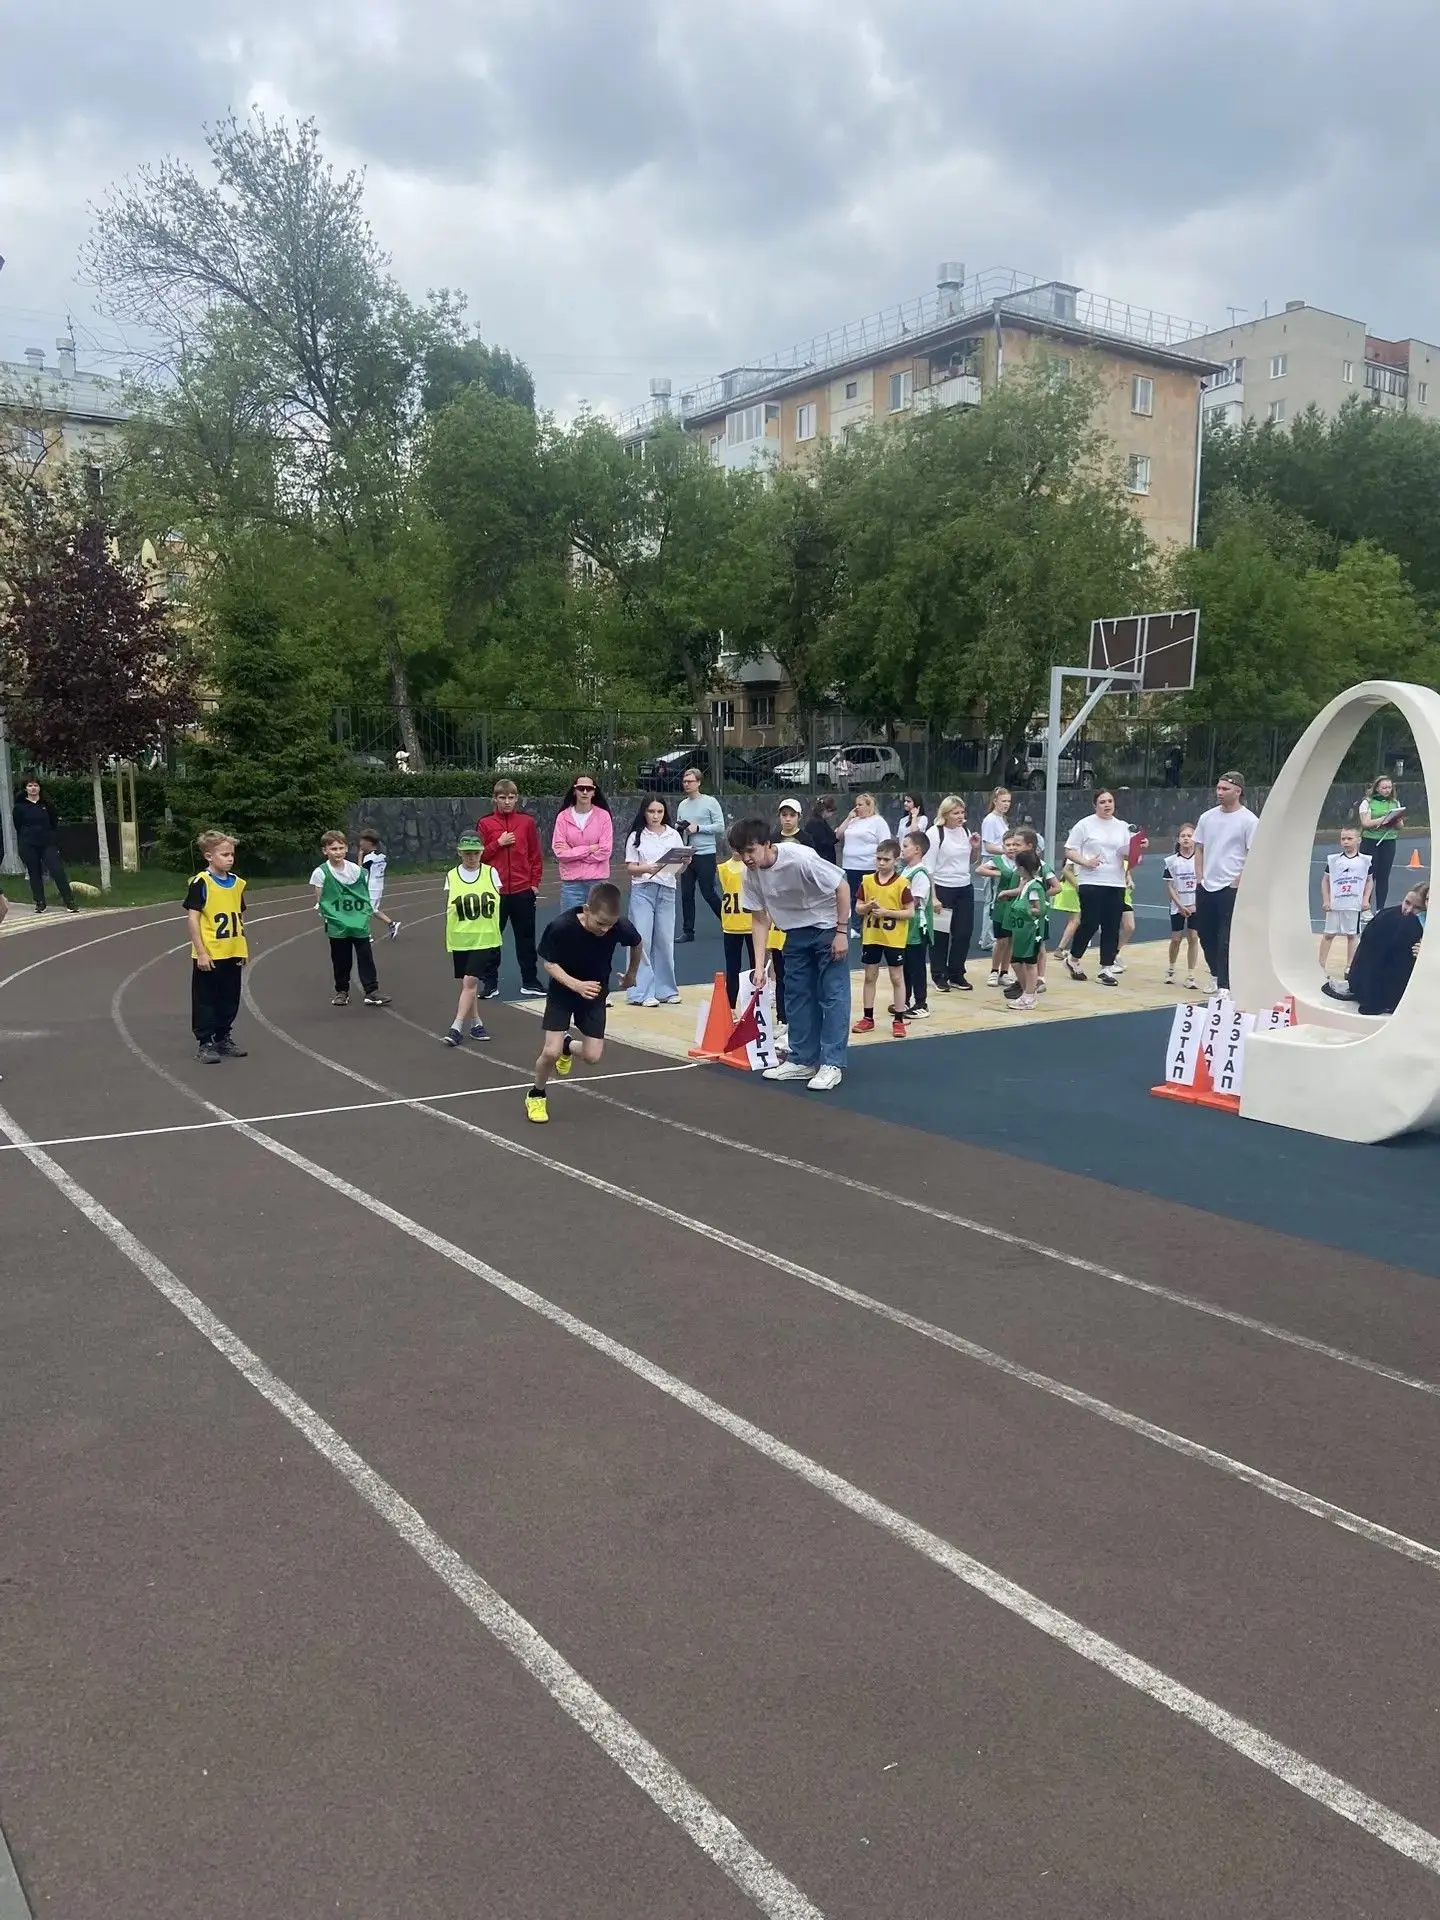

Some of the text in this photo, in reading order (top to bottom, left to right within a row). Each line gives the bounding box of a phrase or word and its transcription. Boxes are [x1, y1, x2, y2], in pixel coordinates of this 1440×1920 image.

[331, 899, 365, 912] 180
[451, 891, 496, 922] 106
[1215, 998, 1223, 1011] 1
[1270, 1011, 1280, 1024] 5
[1172, 1004, 1194, 1079] 3 ЭТАП
[1220, 1012, 1242, 1089] 2 ЭТАП
